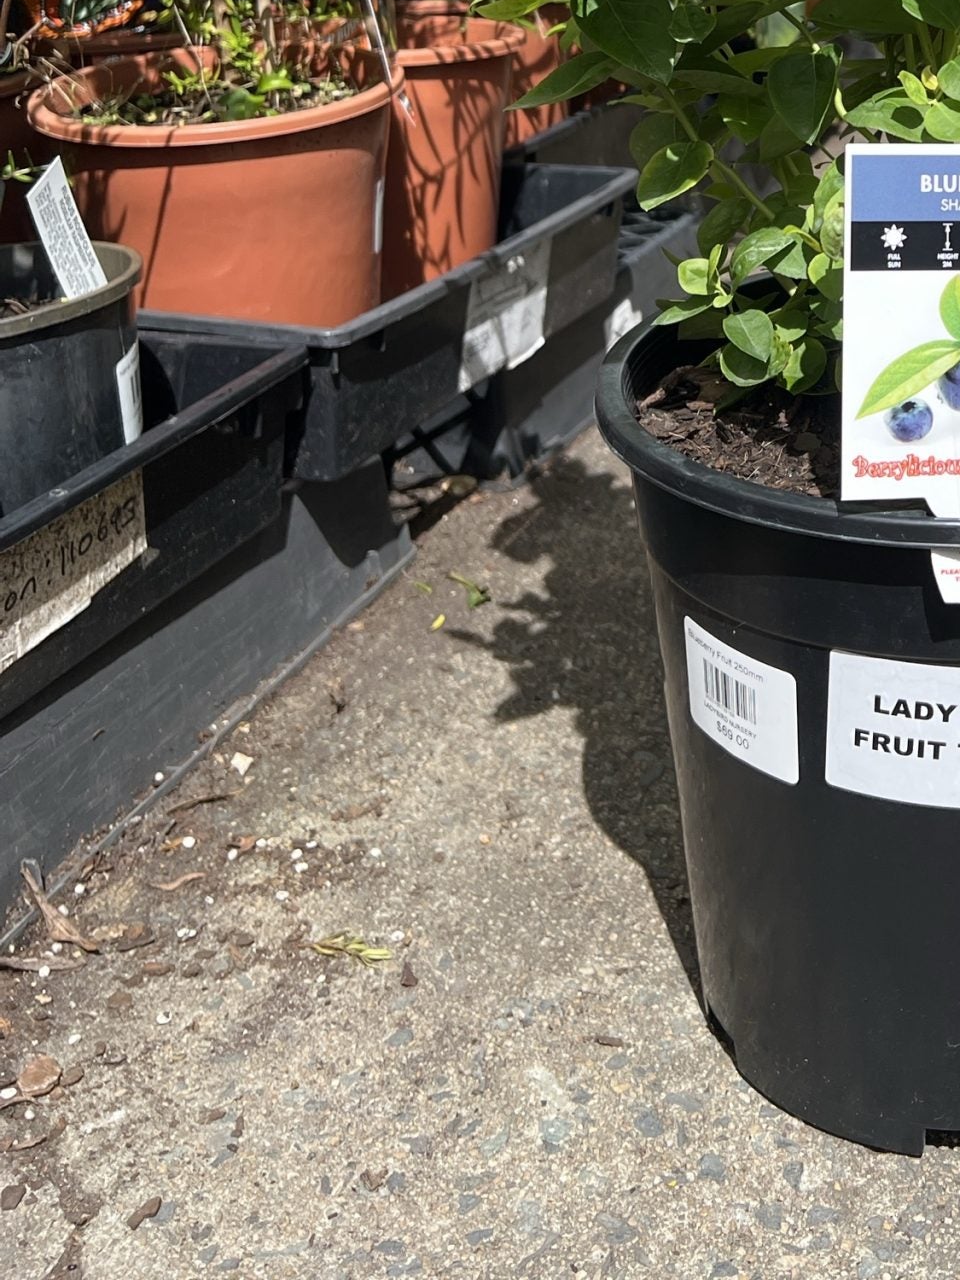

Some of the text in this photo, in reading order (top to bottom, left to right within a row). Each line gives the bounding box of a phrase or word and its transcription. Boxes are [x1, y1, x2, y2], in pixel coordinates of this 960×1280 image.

[716, 649, 734, 667] Fruit
[734, 660, 764, 682] 250mm
[873, 694, 958, 723] LADY
[853, 729, 946, 760] FRUIT
